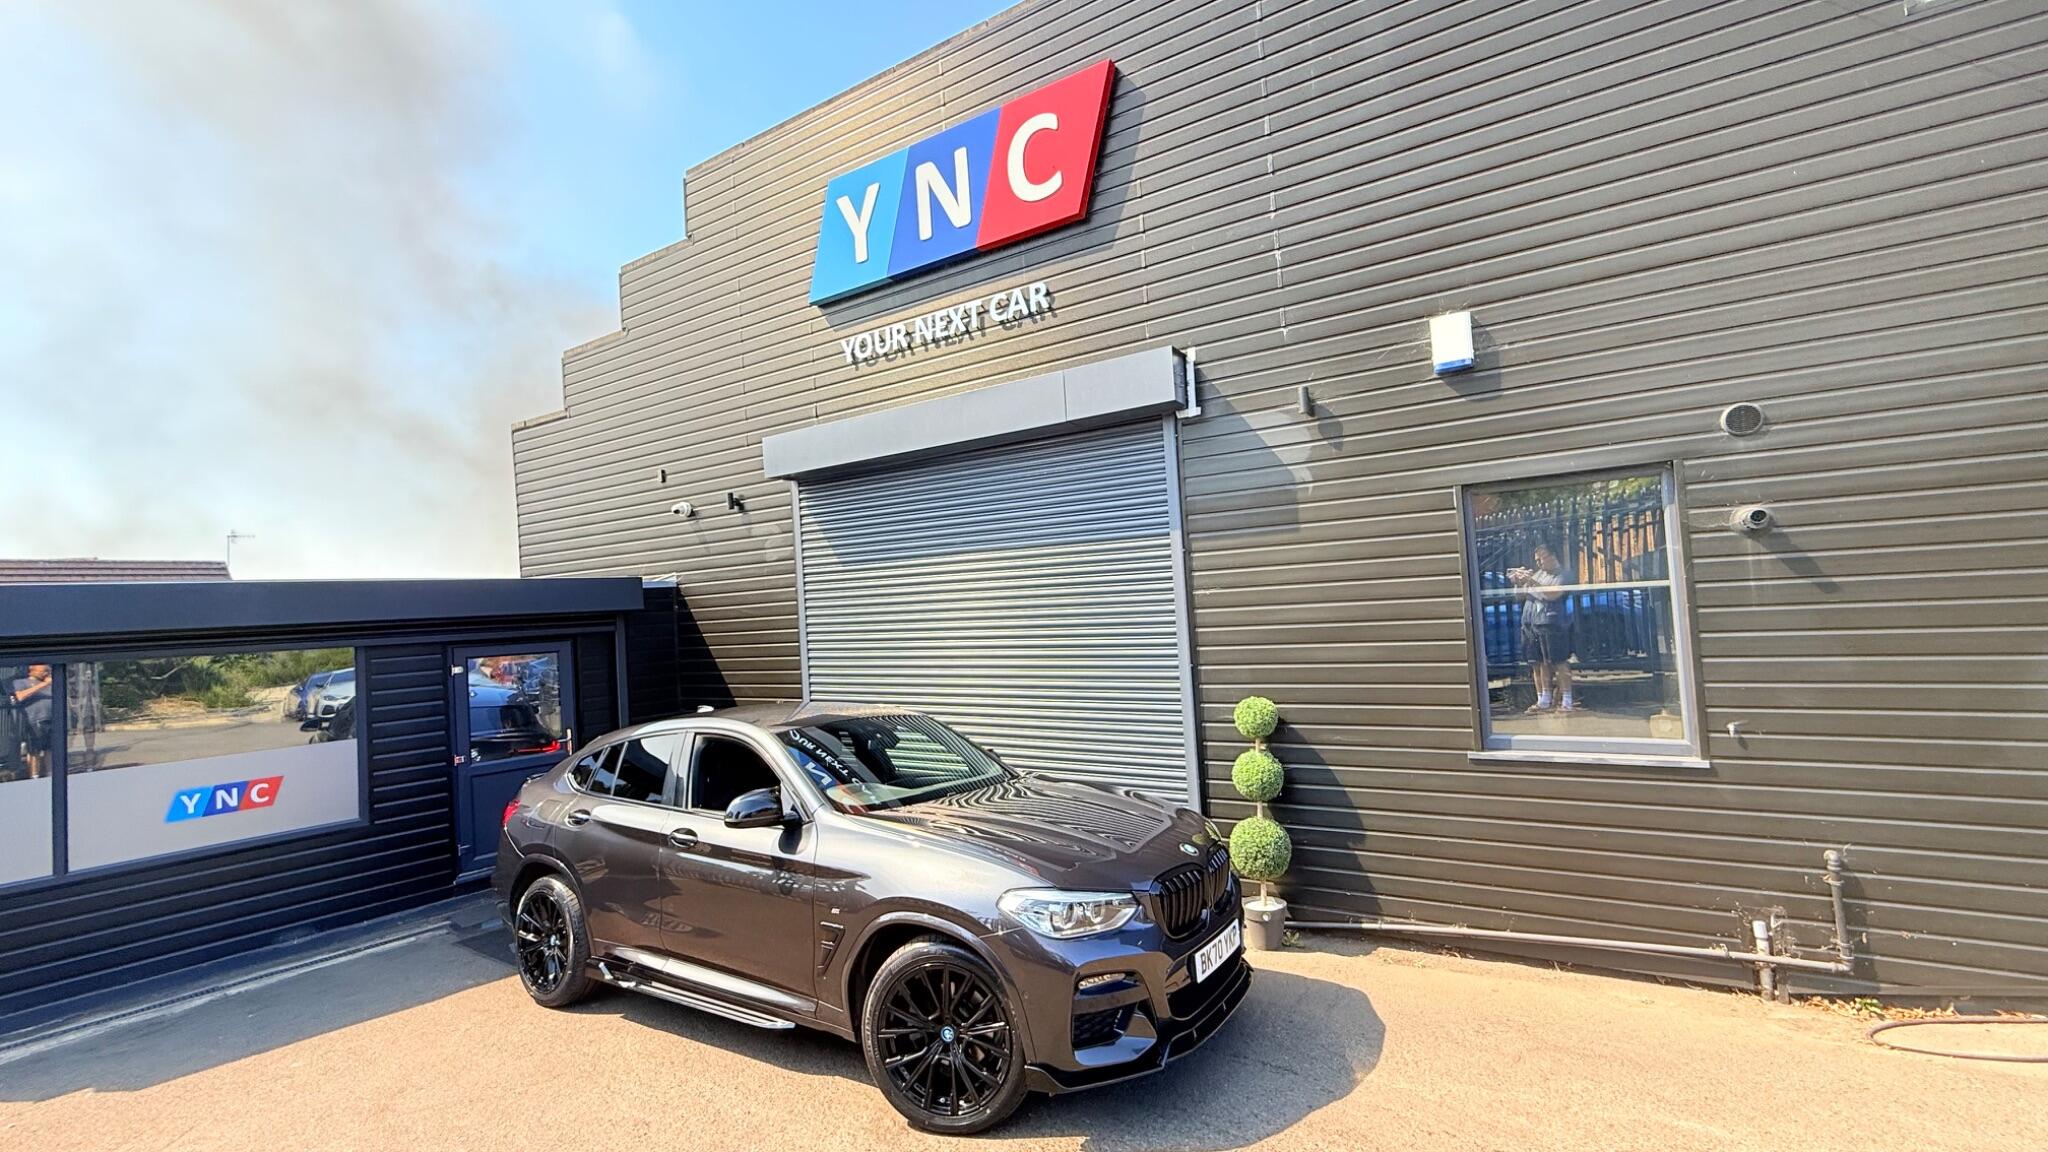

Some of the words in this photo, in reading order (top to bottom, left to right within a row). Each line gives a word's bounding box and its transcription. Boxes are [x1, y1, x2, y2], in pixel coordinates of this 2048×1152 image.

[836, 112, 1063, 264] YNC
[841, 324, 908, 363] YOUR
[914, 300, 982, 345] NEXT
[989, 282, 1049, 322] CAR
[180, 782, 270, 814] YNC
[1200, 939, 1223, 975] BK70
